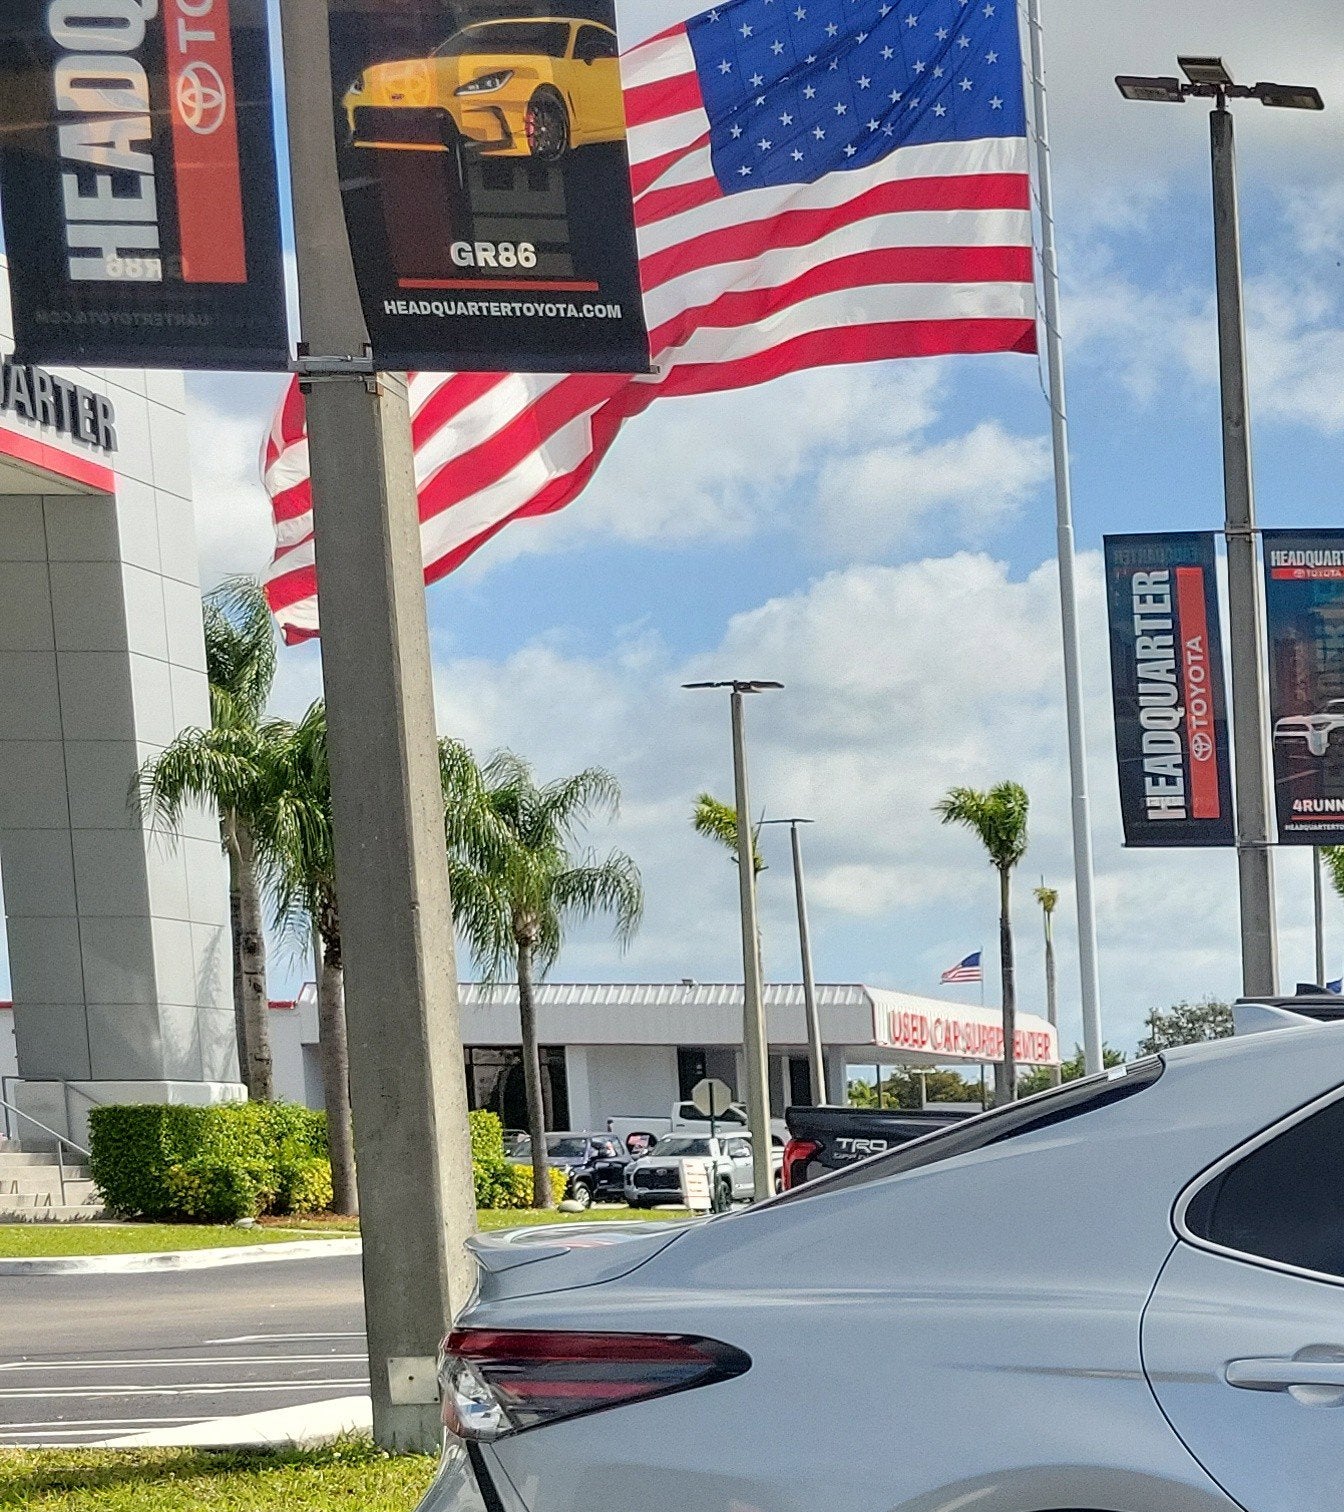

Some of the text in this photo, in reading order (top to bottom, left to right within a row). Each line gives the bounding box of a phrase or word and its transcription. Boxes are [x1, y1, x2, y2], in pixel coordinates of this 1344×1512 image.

[450, 241, 537, 268] GR86
[383, 300, 622, 319] HEADQUARTERTOYOTA.COM
[0, 363, 118, 453] ARTER
[1132, 569, 1187, 820] HEADQUARTER
[1185, 635, 1210, 729] TOYOTA
[889, 1010, 929, 1046] USED
[931, 1017, 960, 1051] CAR
[1013, 1030, 1051, 1061] ENTER
